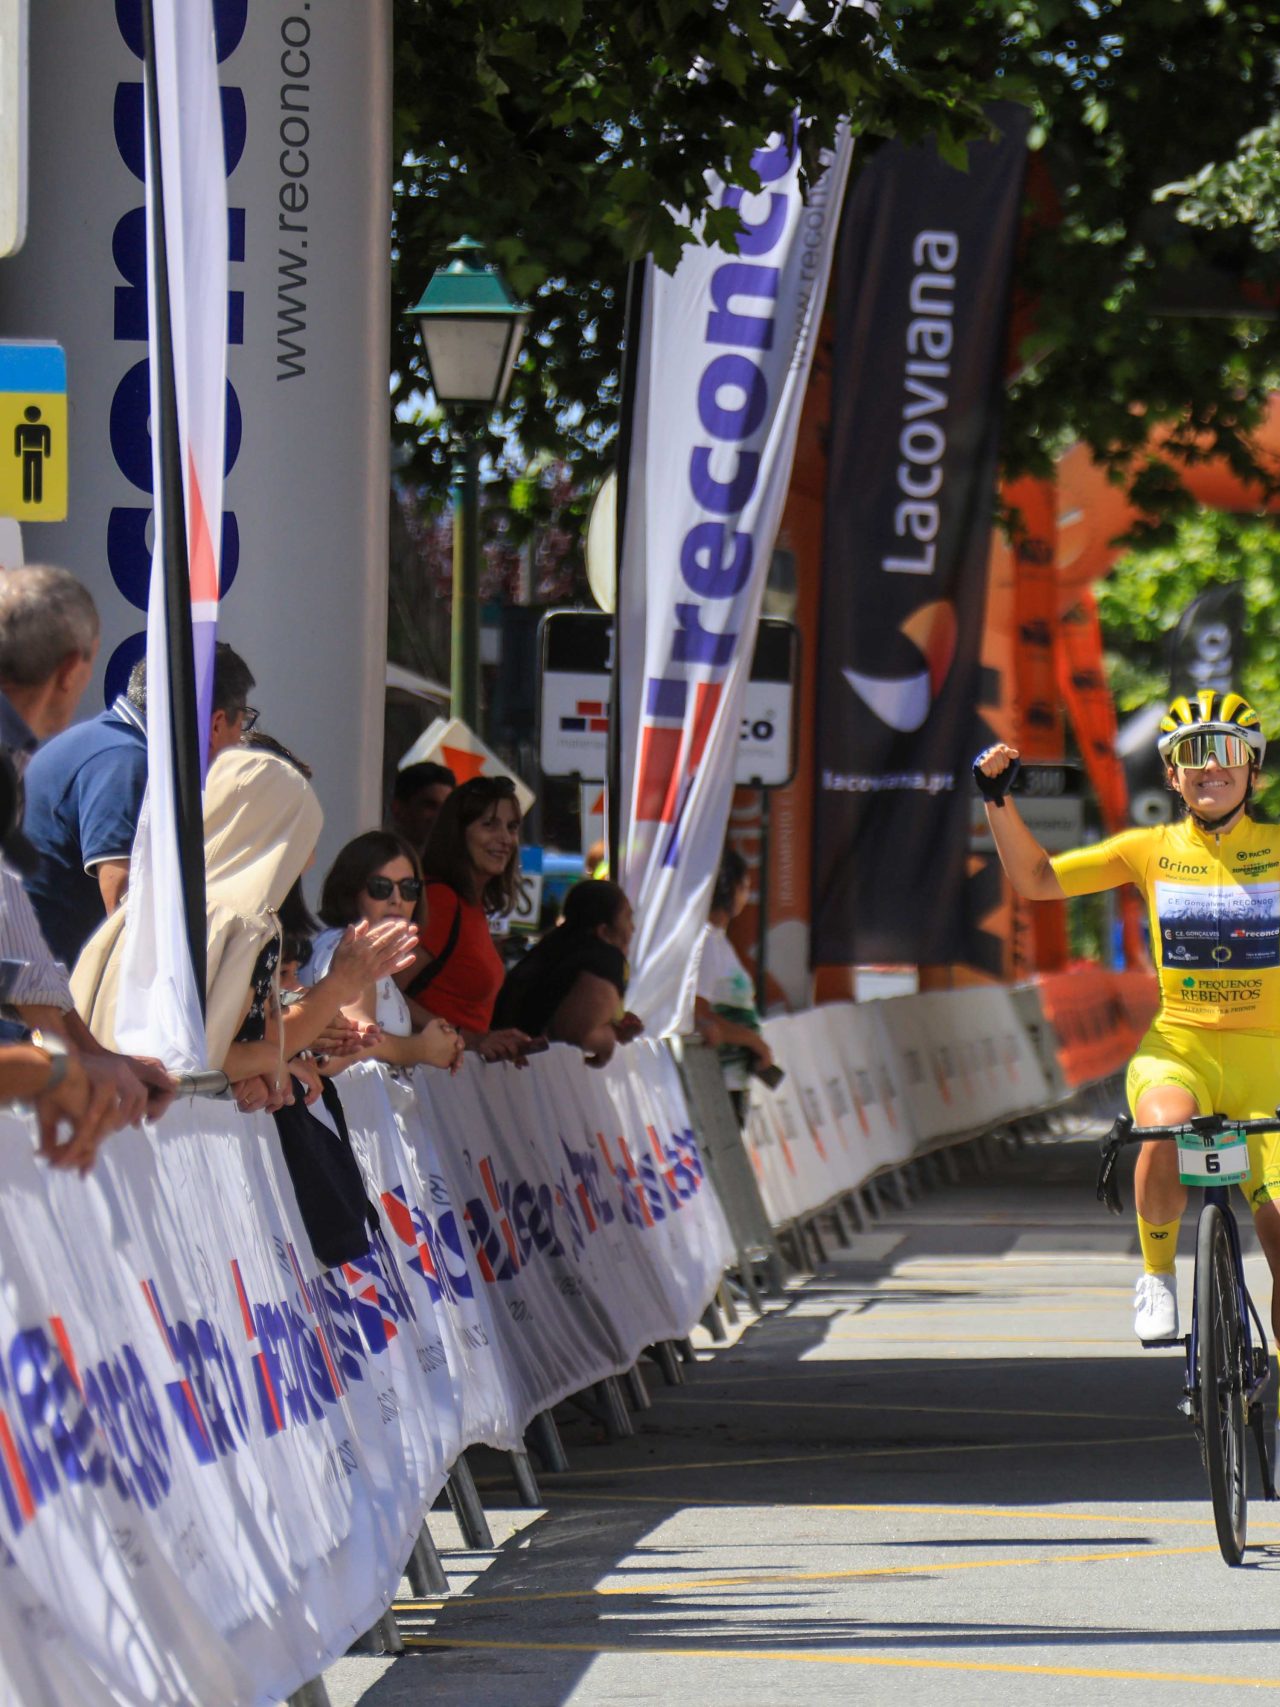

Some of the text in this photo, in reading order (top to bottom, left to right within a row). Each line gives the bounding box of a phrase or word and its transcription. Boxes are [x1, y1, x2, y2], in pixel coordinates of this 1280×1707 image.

[882, 229, 959, 576] Lacoviana
[1158, 856, 1208, 875] Brinox
[1198, 979, 1263, 990] PEQUENOS
[1181, 989, 1261, 1003] REBENTOS
[1205, 1153, 1221, 1174] 6
